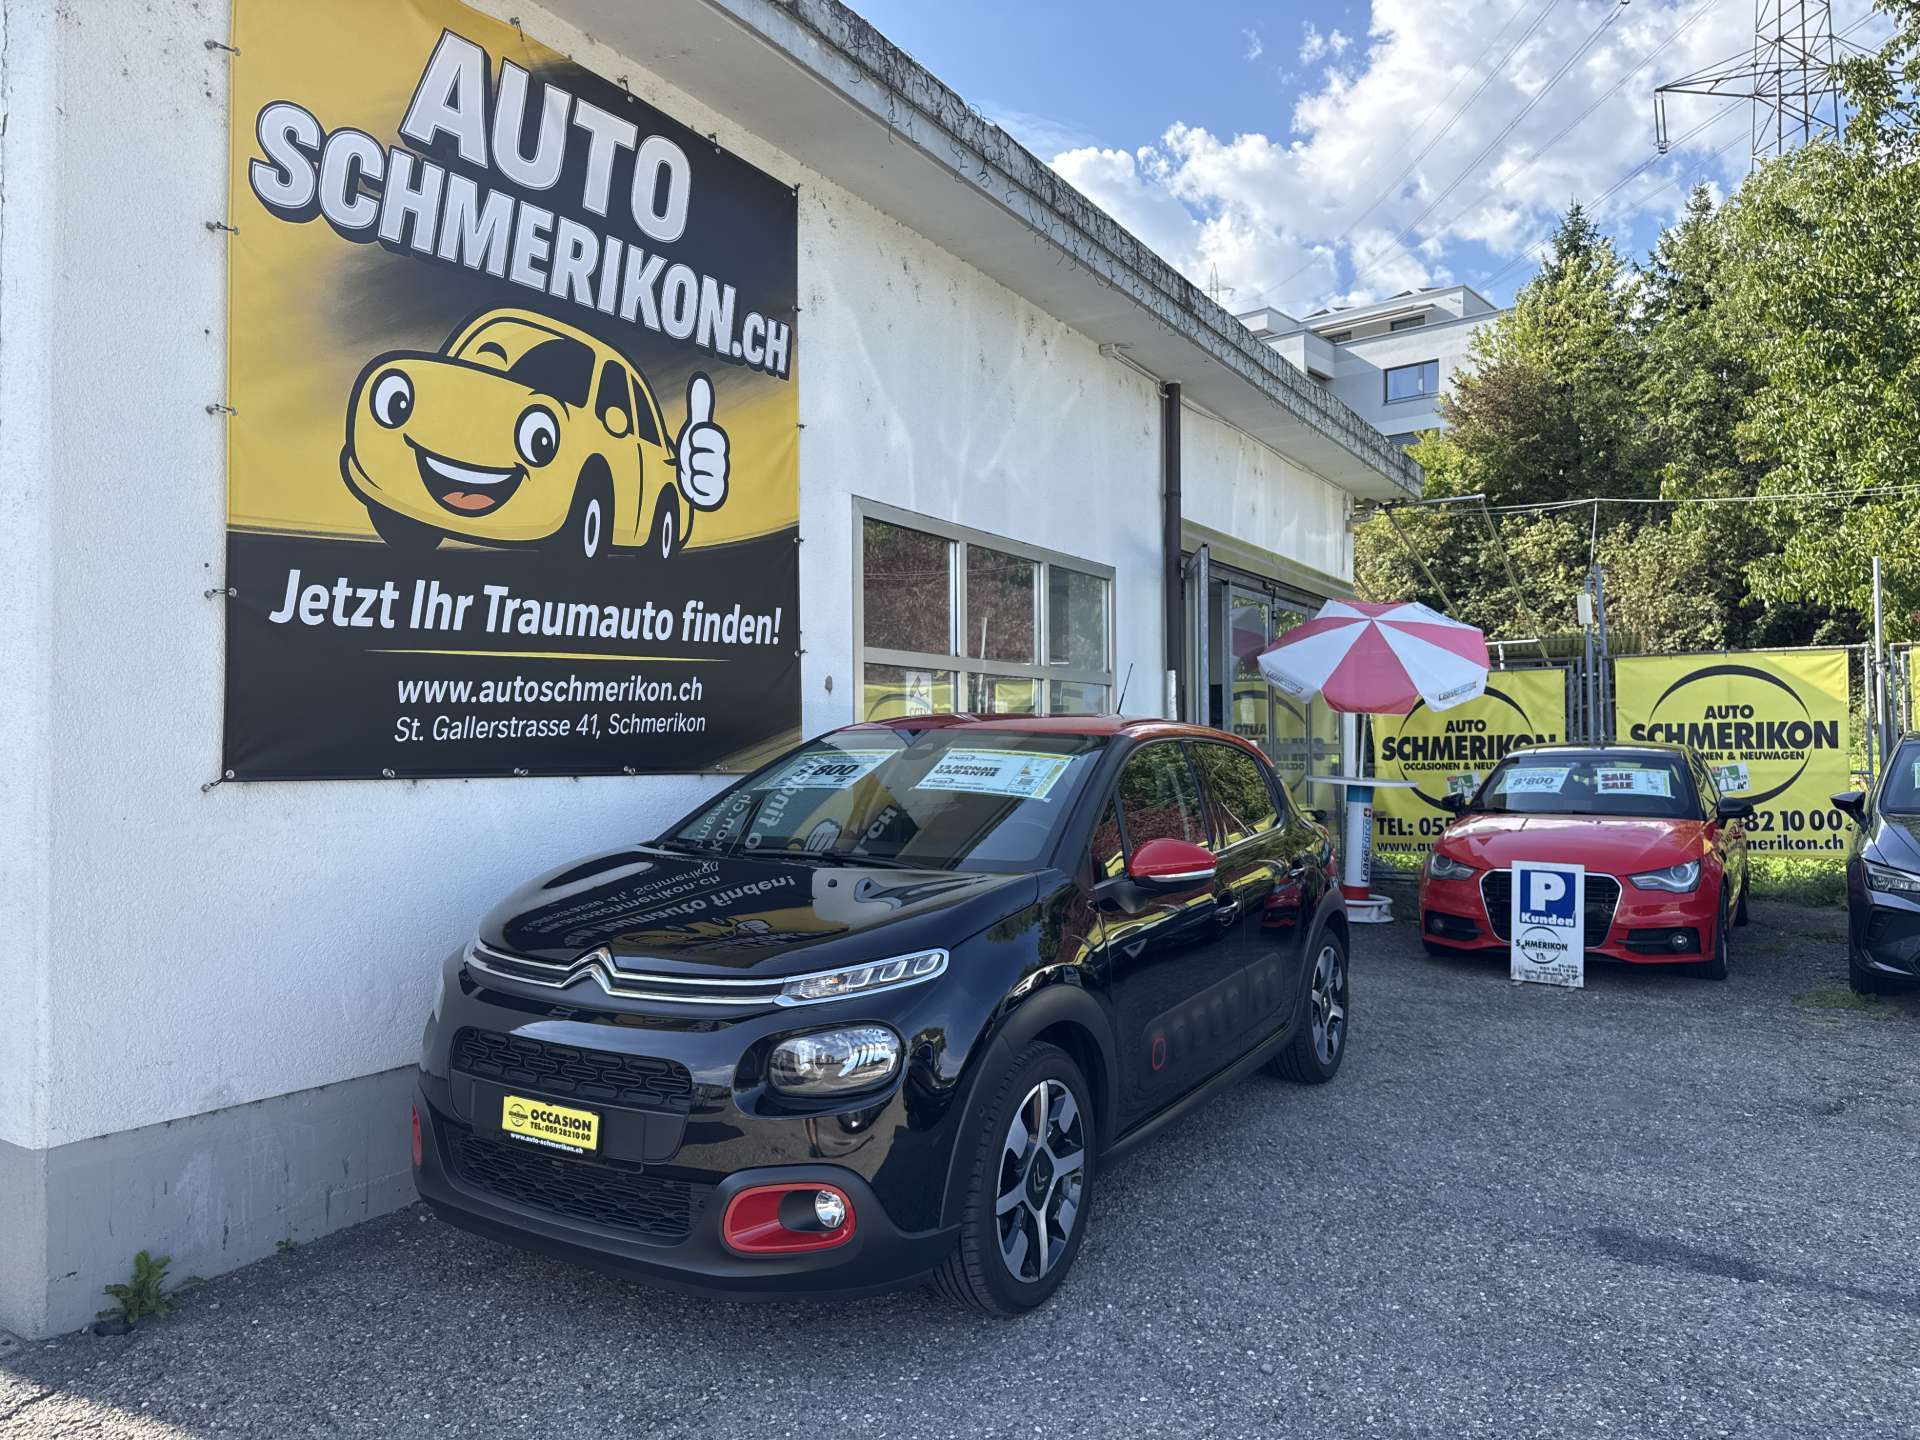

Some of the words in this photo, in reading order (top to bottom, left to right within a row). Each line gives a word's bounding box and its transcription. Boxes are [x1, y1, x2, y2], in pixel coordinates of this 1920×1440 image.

[401, 29, 692, 243] AUTO
[251, 101, 791, 377] SCHMERIKON.CH
[269, 569, 399, 628] Jetzt
[409, 579, 473, 631] Ihr
[483, 585, 674, 641] Traumauto
[682, 600, 782, 645] finden!
[397, 675, 703, 704] www.autoschmerikon.ch
[1704, 705, 1754, 719] AUTO
[393, 716, 425, 743] St.
[432, 714, 570, 740] Gallerstrasse
[576, 713, 602, 740] 41,
[608, 712, 706, 735] Schmerikon
[1445, 720, 1487, 733] AUTO
[1630, 720, 1839, 750] SCHMERIKON
[1728, 751, 1736, 760] &
[1740, 751, 1805, 760] NEUWAGEN
[934, 769, 999, 777] GARANTIE
[1403, 762, 1460, 771] OCCASIONEN
[1463, 762, 1471, 770] &
[1474, 762, 1498, 770] NEU
[1601, 773, 1633, 782] SALE
[1601, 782, 1634, 790] SALE
[1377, 817, 1414, 836] TEL:
[1780, 810, 1805, 831] 10
[1809, 810, 1843, 831] 00
[1361, 818, 1372, 883] LeaseForce
[1530, 871, 1566, 911] P
[1521, 912, 1574, 926] Kunden
[530, 1122, 544, 1131] TEL:
[545, 1125, 557, 1134] 055
[531, 1109, 592, 1132] OCCASION
